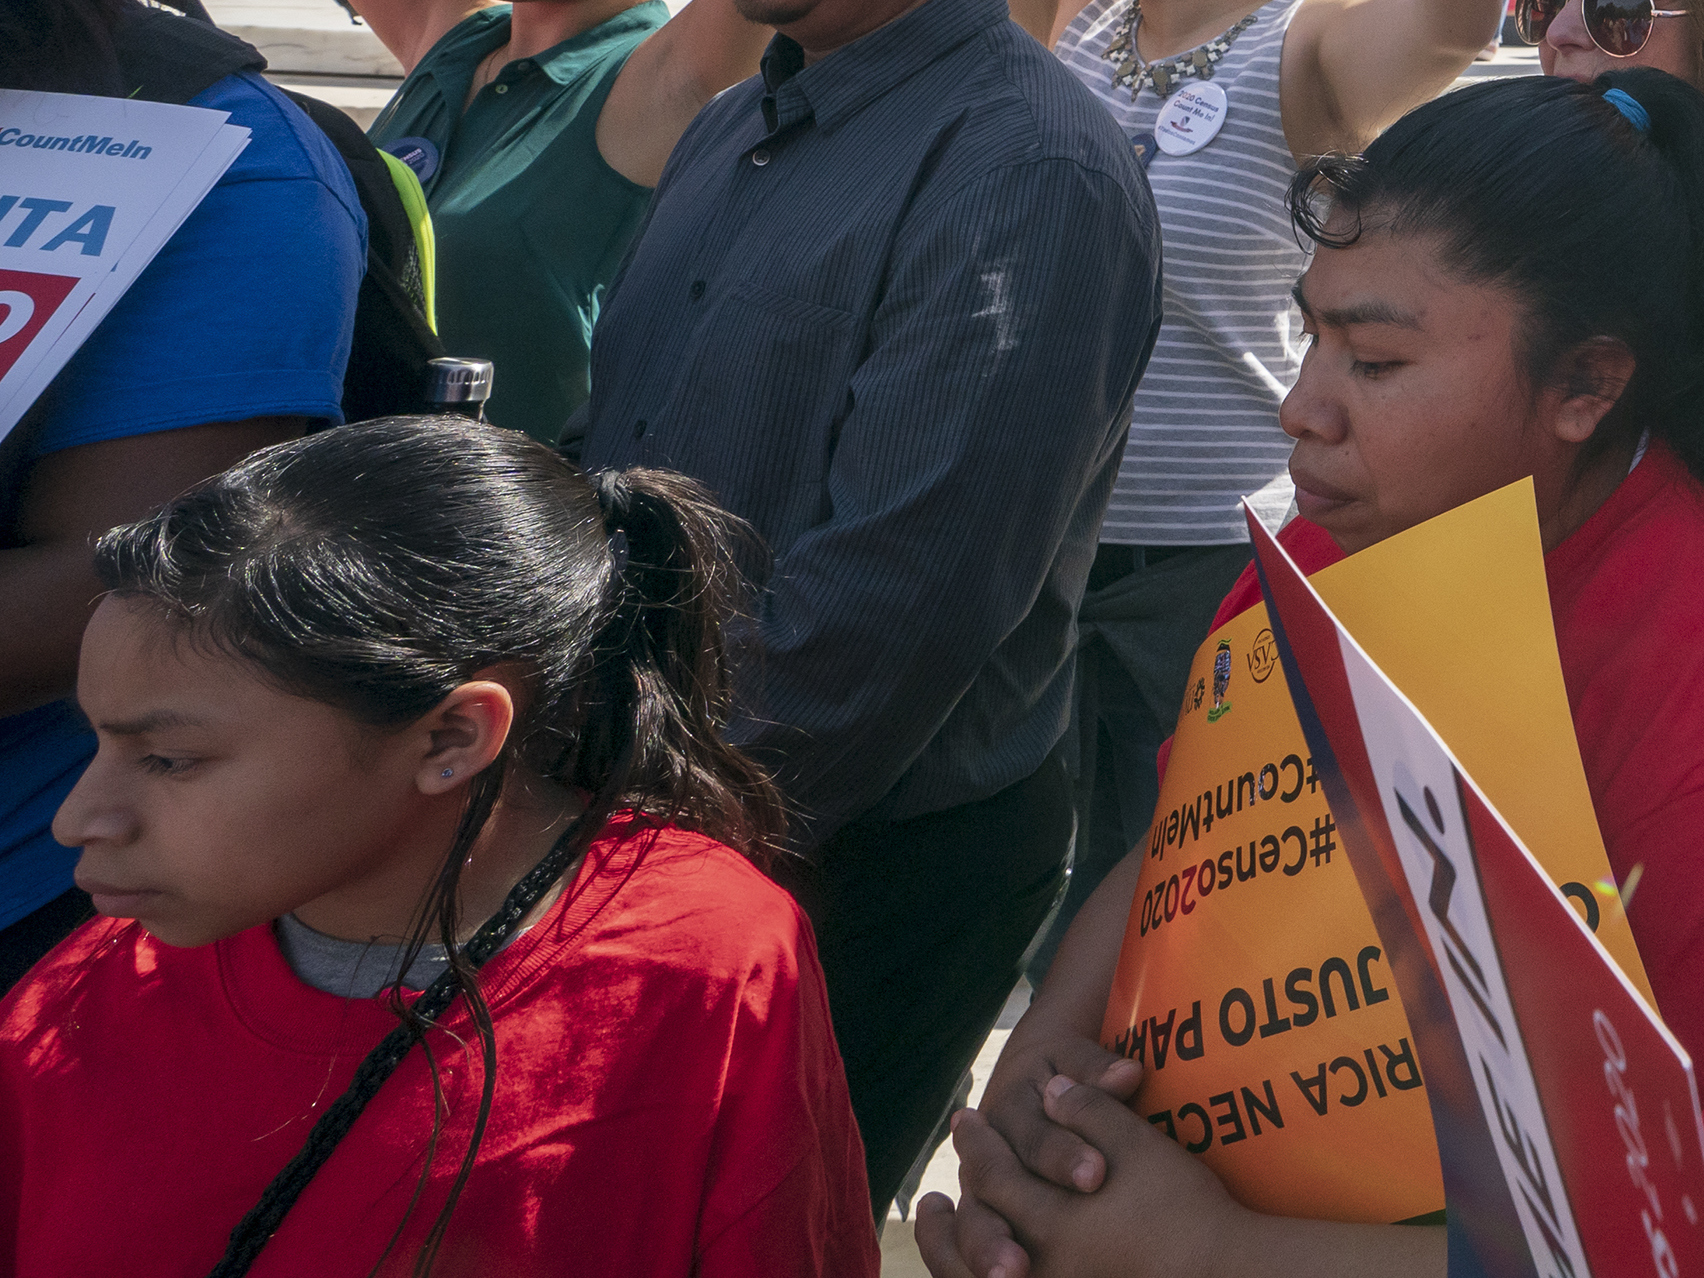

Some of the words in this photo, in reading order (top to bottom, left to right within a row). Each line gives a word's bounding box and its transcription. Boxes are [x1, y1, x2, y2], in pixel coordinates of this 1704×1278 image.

[0, 126, 152, 159] CountMeIn
[1140, 814, 1336, 937] #Censo2020
[1219, 945, 1390, 1048] JUSTO
